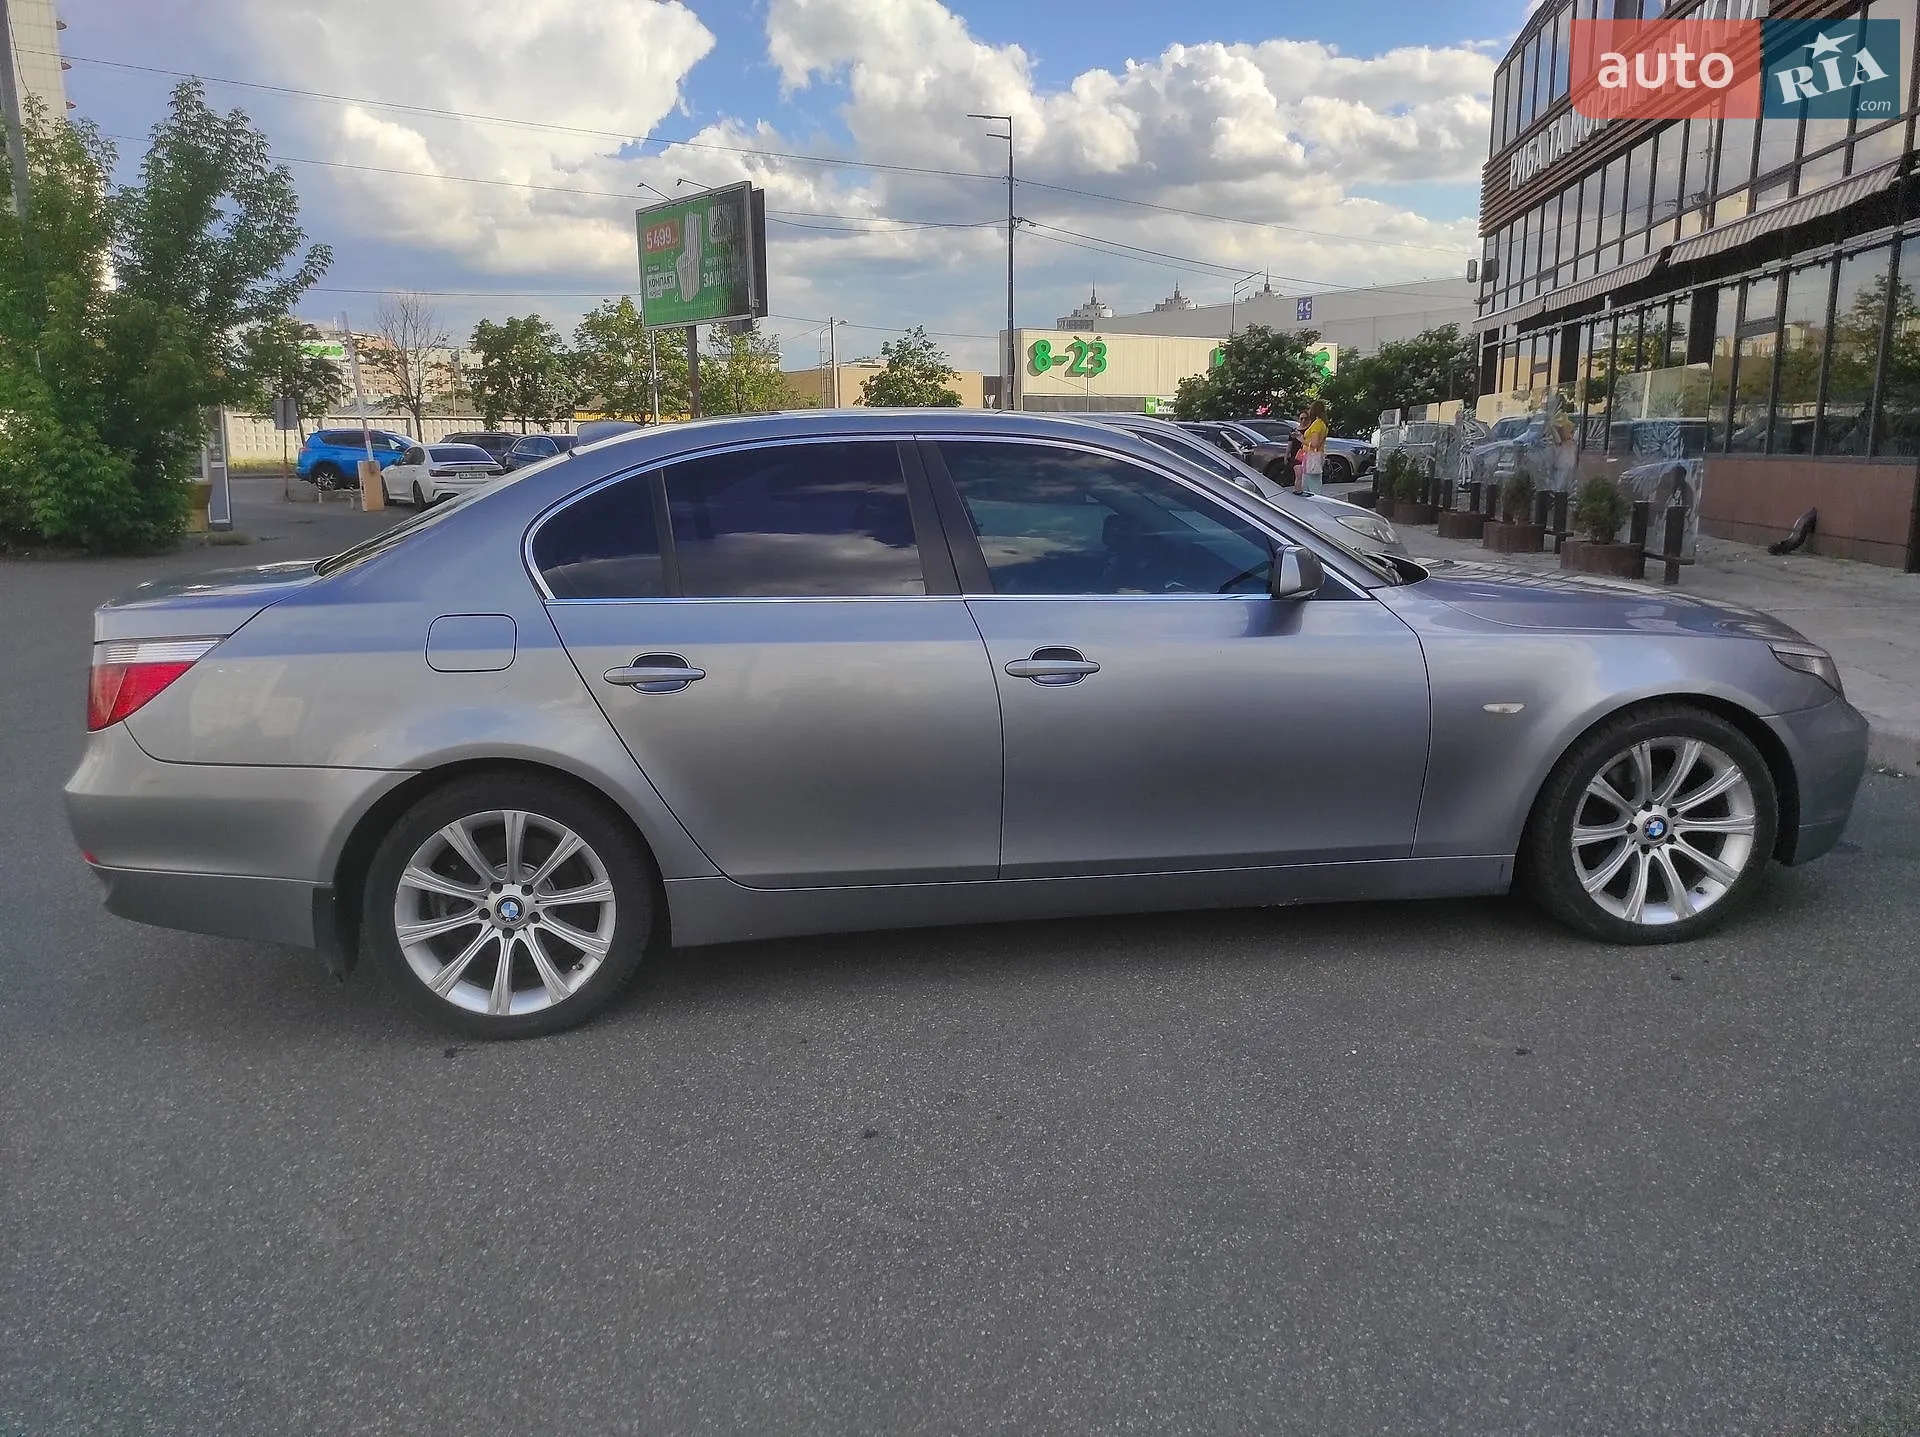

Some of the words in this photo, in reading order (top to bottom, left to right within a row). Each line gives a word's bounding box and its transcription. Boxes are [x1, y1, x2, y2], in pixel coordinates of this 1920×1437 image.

[1509, 132, 1550, 191] РИБА
[1549, 113, 1573, 163] ТА
[1029, 338, 1108, 376] 8-23
